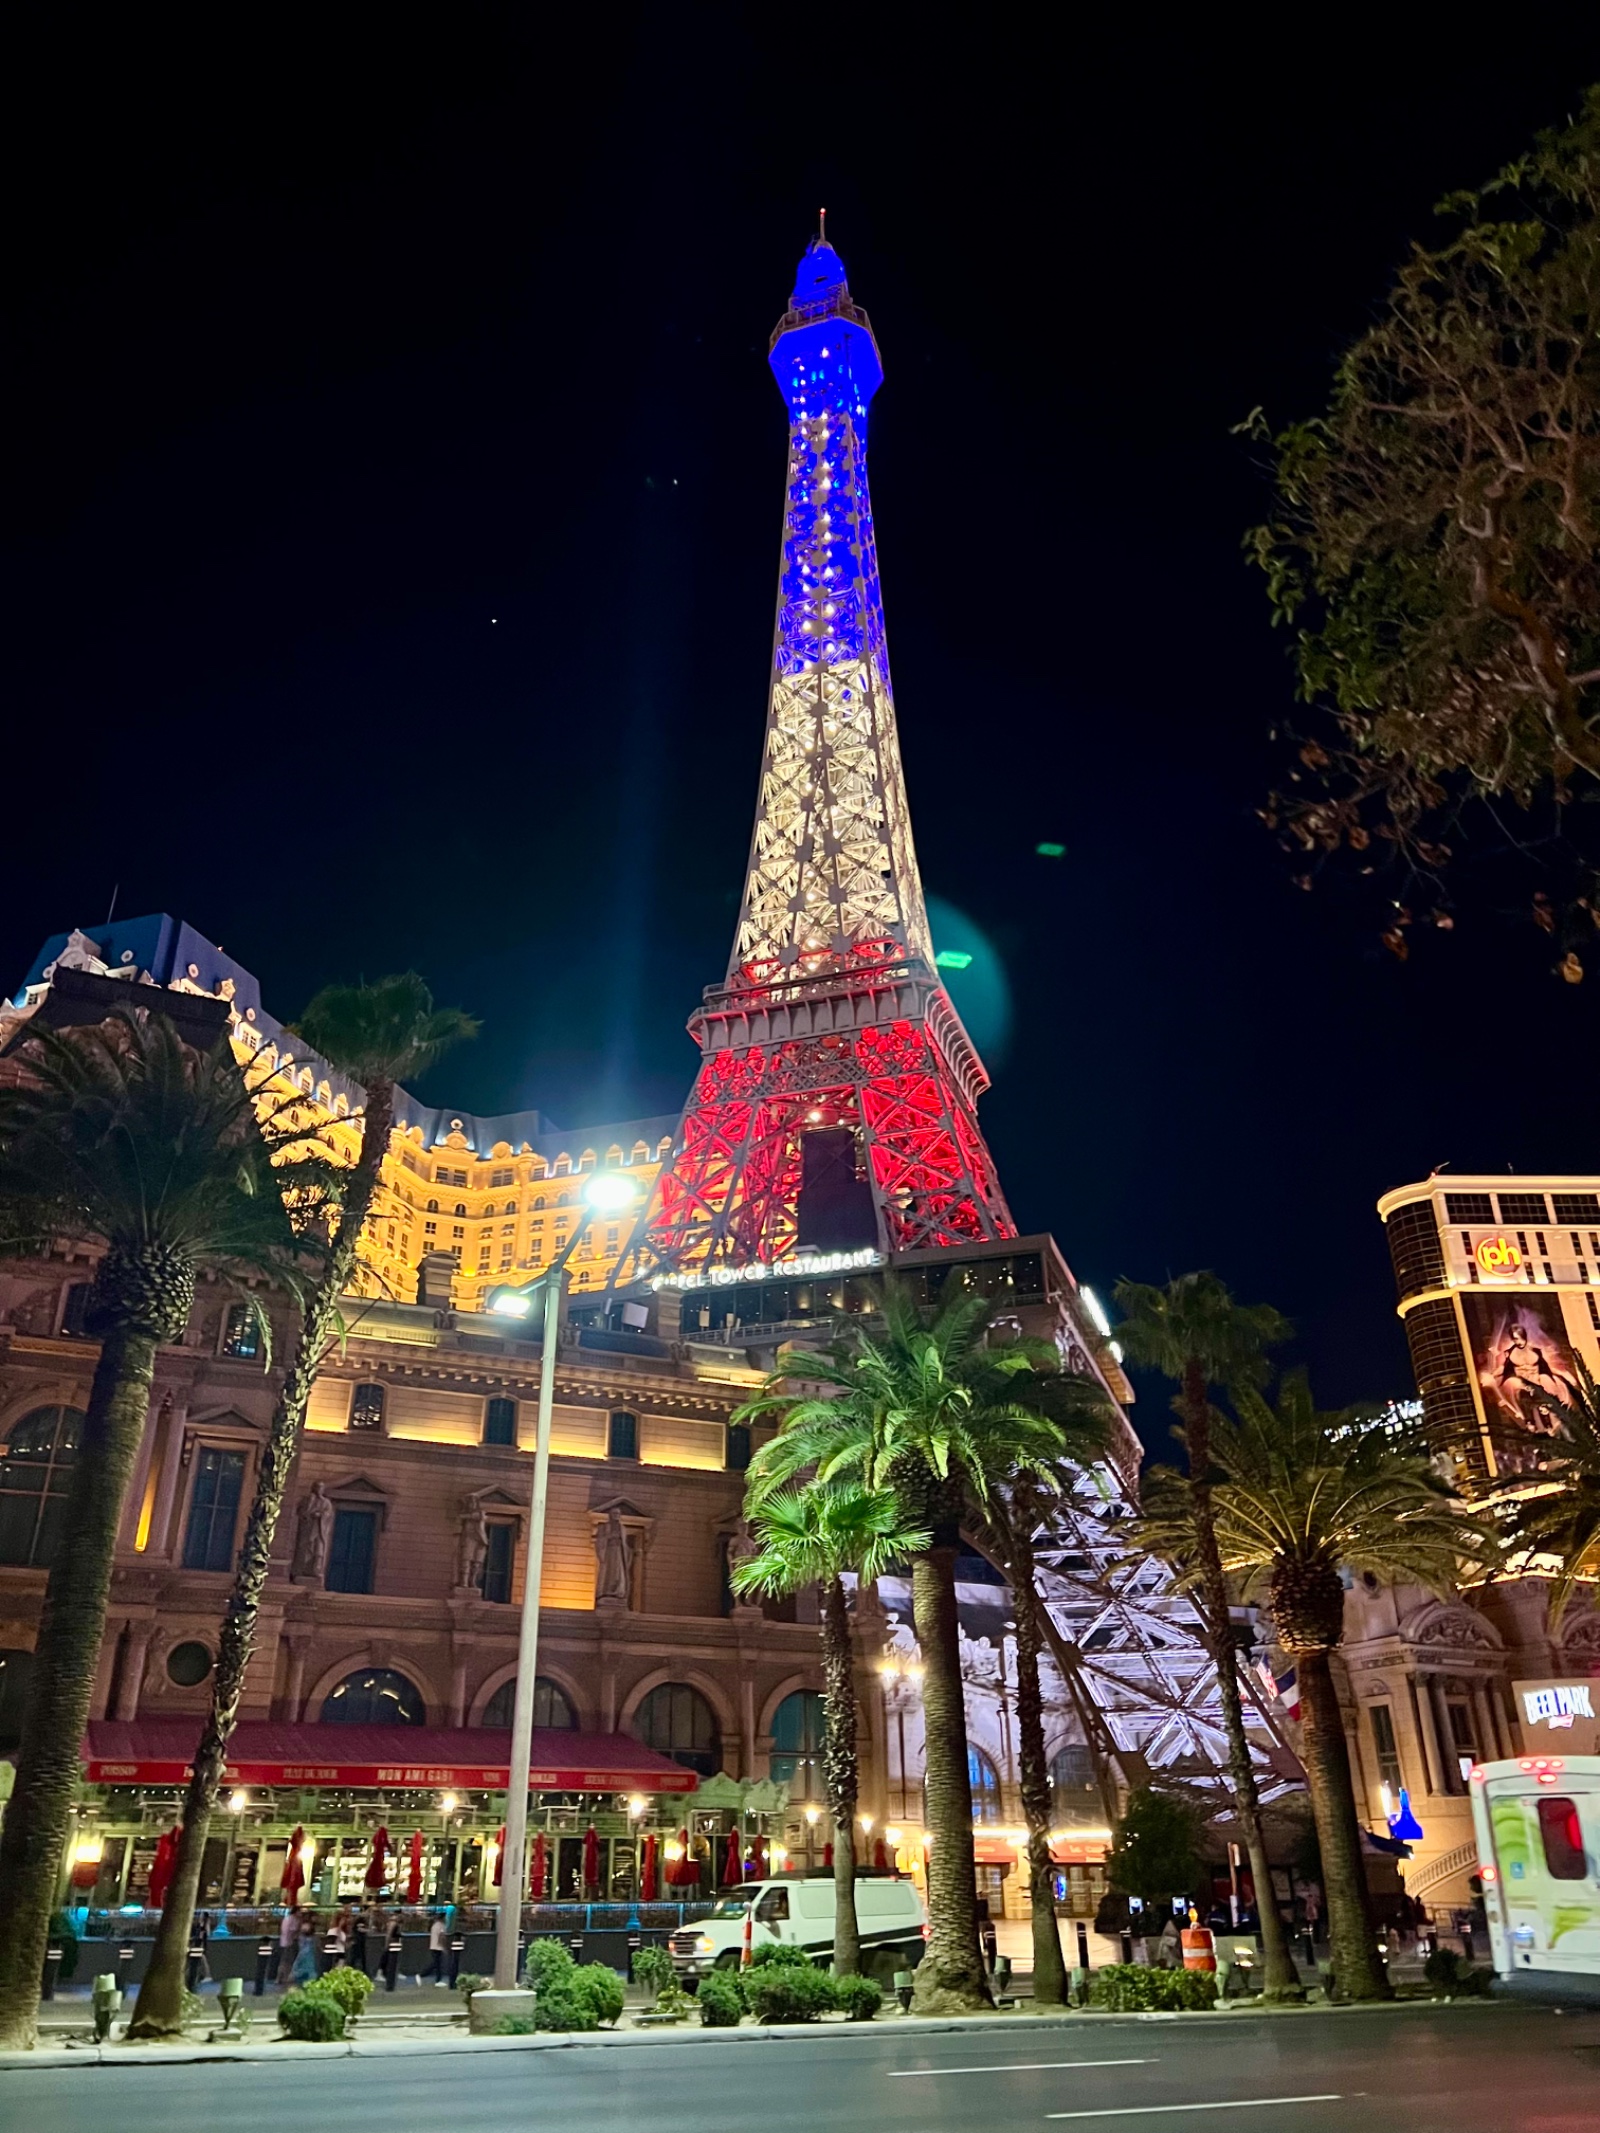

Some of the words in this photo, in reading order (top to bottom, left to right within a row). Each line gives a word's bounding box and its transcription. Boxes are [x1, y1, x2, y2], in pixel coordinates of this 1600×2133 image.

[708, 1263, 766, 1287] TOWER
[773, 1248, 876, 1278] RESTAURANT
[1554, 1685, 1595, 1718] PARK
[377, 1768, 402, 1781] MON
[404, 1769, 425, 1782] AMI
[427, 1769, 454, 1782] GABI
